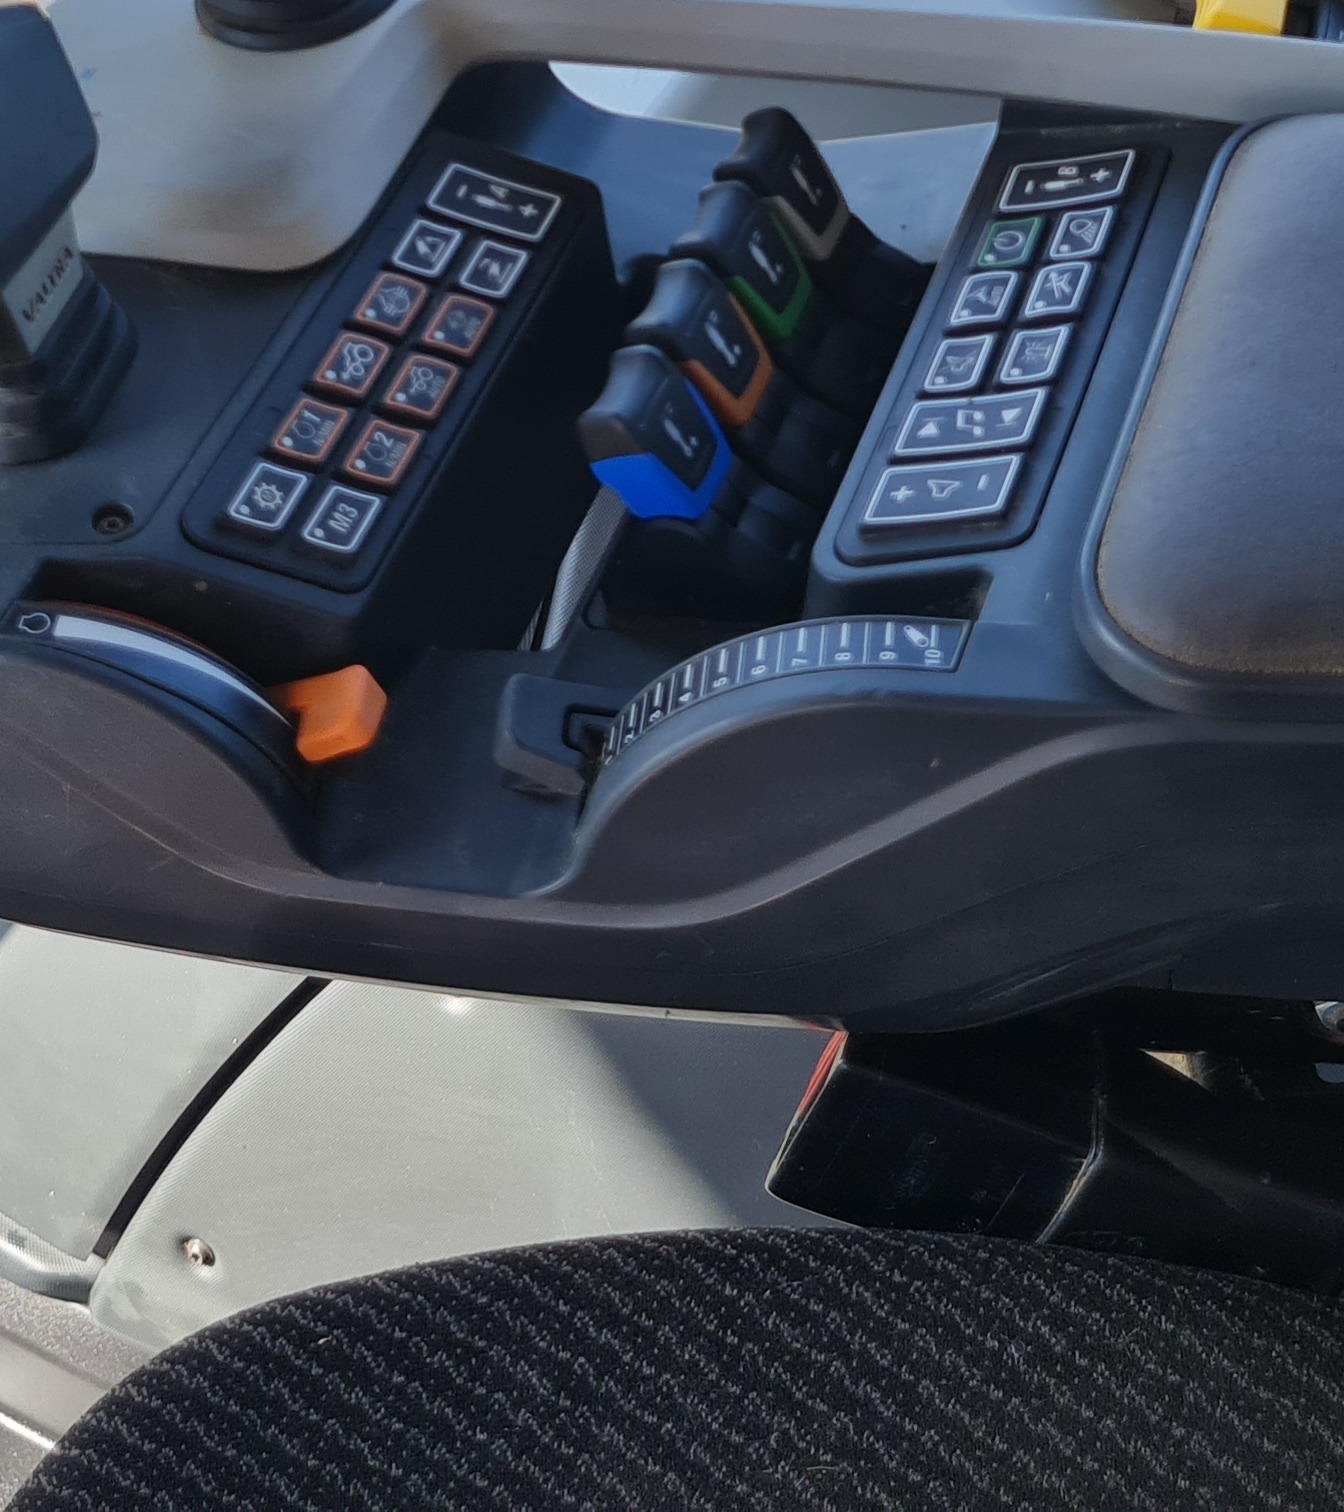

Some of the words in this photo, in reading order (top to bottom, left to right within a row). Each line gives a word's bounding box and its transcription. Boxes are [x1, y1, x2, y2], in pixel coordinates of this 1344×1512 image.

[1058, 166, 1079, 176] B
[302, 409, 321, 422] 1
[373, 431, 394, 447] 2
[327, 502, 359, 534] M3
[649, 709, 662, 723] 3
[678, 691, 693, 704] 4
[713, 676, 728, 688] 5
[751, 664, 767, 676] 6
[791, 657, 808, 667] 7
[834, 651, 852, 661] 8
[879, 650, 897, 660] 9
[924, 648, 943, 666] 10
